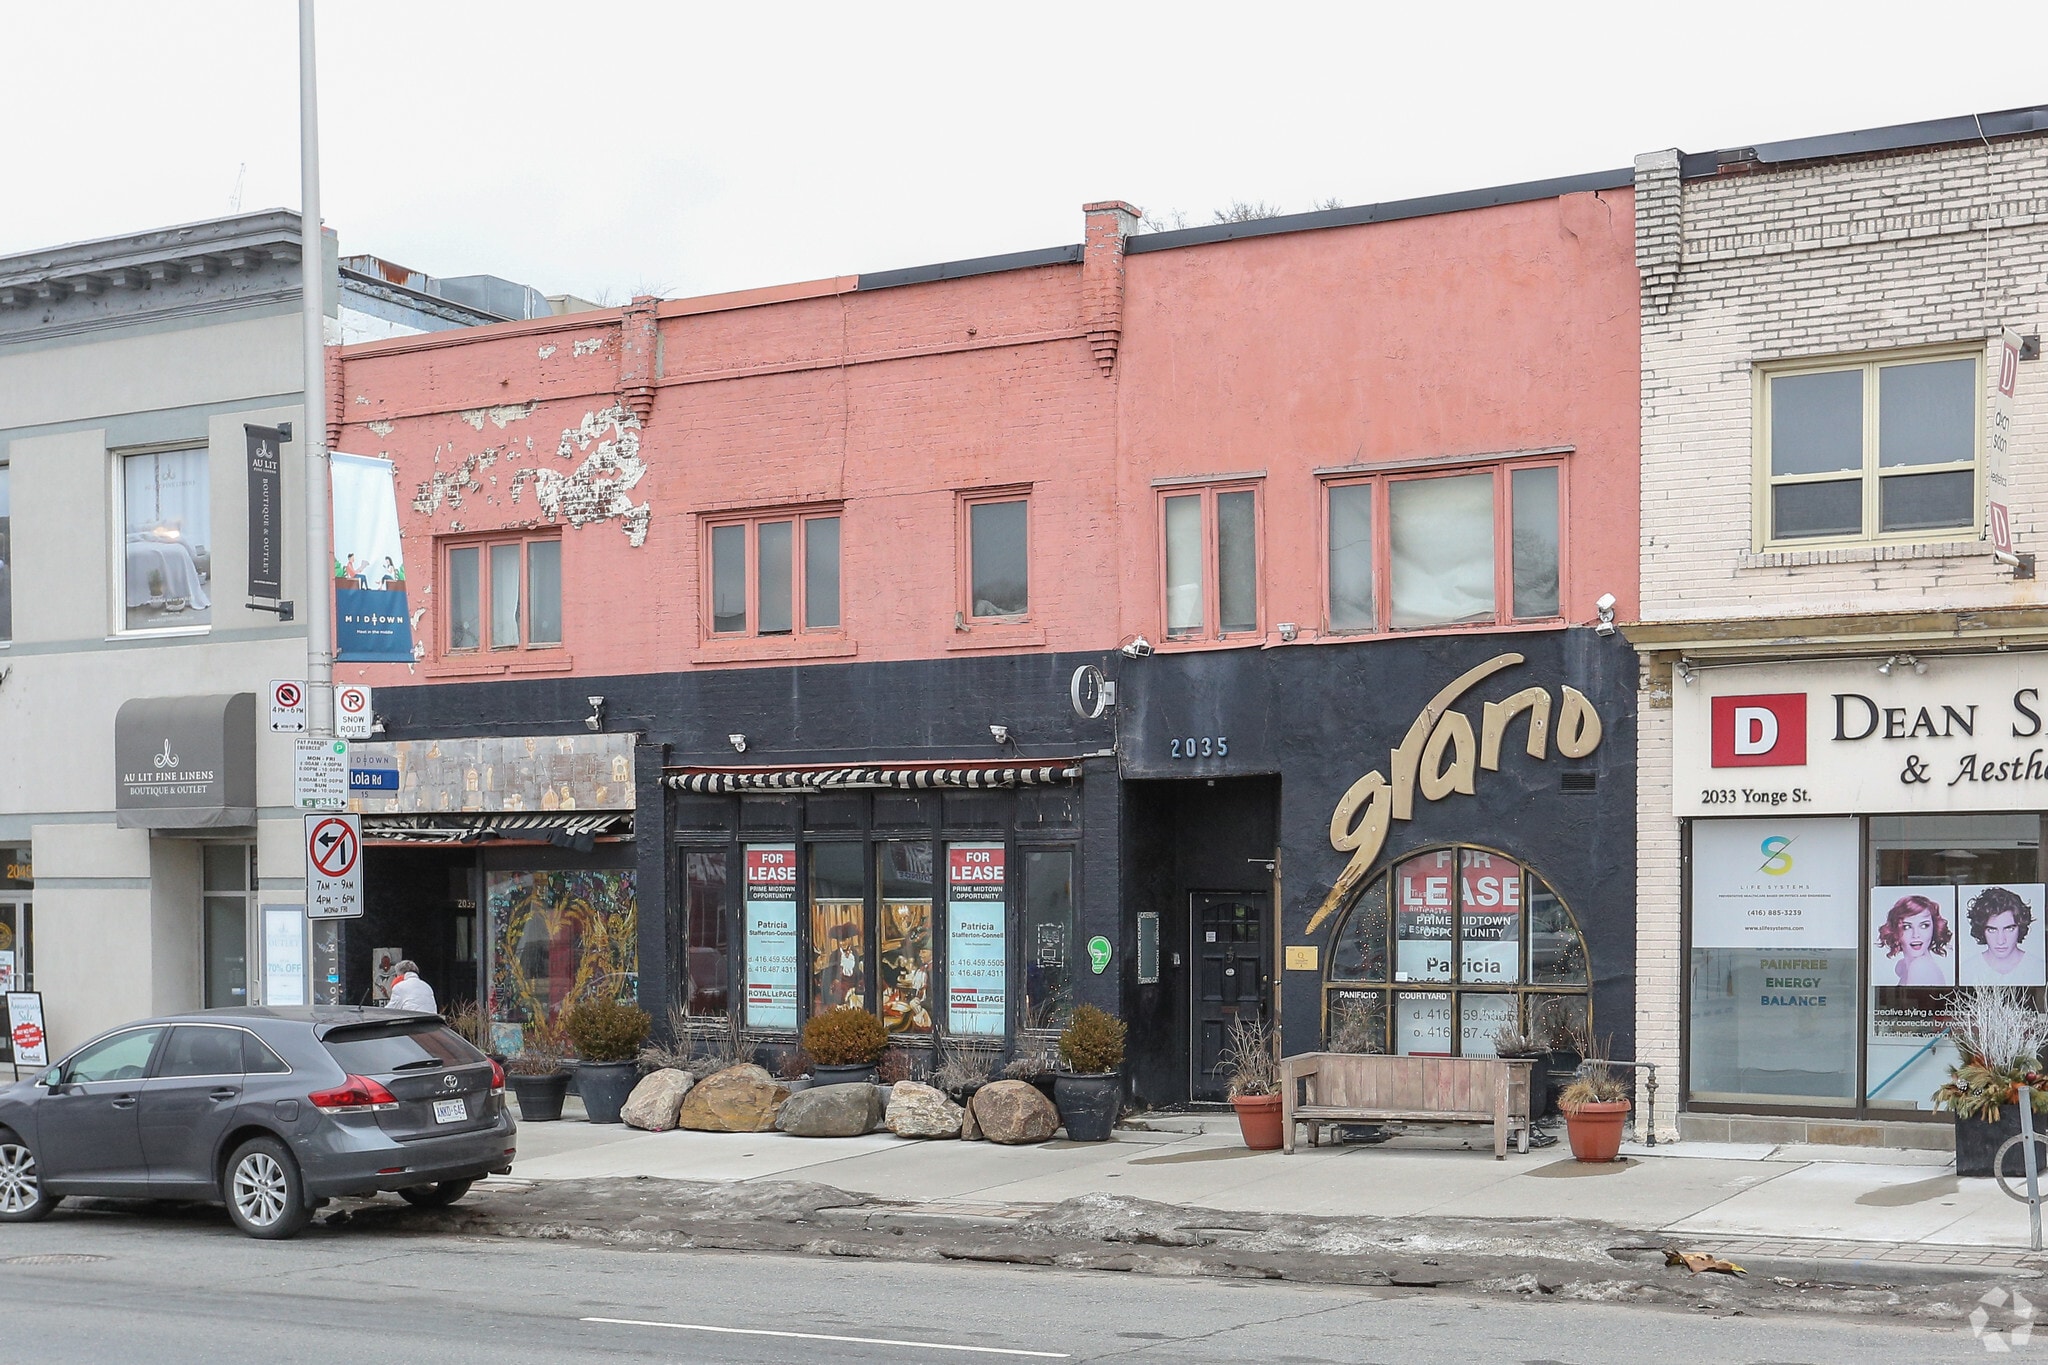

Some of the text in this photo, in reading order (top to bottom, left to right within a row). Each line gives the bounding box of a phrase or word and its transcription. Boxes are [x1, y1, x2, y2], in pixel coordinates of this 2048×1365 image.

[2002, 348, 2014, 390] D
[252, 459, 277, 469] AU LIT
[1993, 508, 2008, 546] D
[345, 613, 403, 626] MIDTOWN
[2012, 688, 2048, 738] S
[1734, 706, 1778, 755] D
[1171, 736, 1228, 759] 2035
[1900, 755, 1931, 784] &
[124, 771, 214, 782] AU LIT FINE LINENS
[351, 771, 382, 785] Lola Rd
[130, 786, 168, 796] BOUTIQUE
[176, 785, 207, 794] OUTLET
[1305, 652, 1602, 935] grano
[1702, 788, 1811, 806] 2033 Yonge St.
[762, 854, 783, 864] FOR
[966, 852, 990, 862] FOR
[749, 867, 796, 880] LEASE
[952, 866, 1004, 880] LEASE
[316, 879, 353, 890] 7AM 9AM
[1404, 877, 1519, 906] LEASE
[316, 894, 354, 904] 4PM 6PM
[1417, 916, 1511, 925] PRIME IDTOWN
[1424, 928, 1504, 938] OPPOTUNITY
[268, 964, 301, 972] 70% OFF
[1427, 958, 1501, 973] Paricia
[1761, 959, 1828, 970] PAINFREE
[1766, 978, 1821, 988] ENERGY
[1340, 991, 1377, 999] PANIFICIO
[1761, 996, 1826, 1006] BALANCE
[1414, 1010, 1423, 1020] d.
[1904, 1008, 1927, 1017] styling
[1414, 1028, 1511, 1039] o. 41687.43
